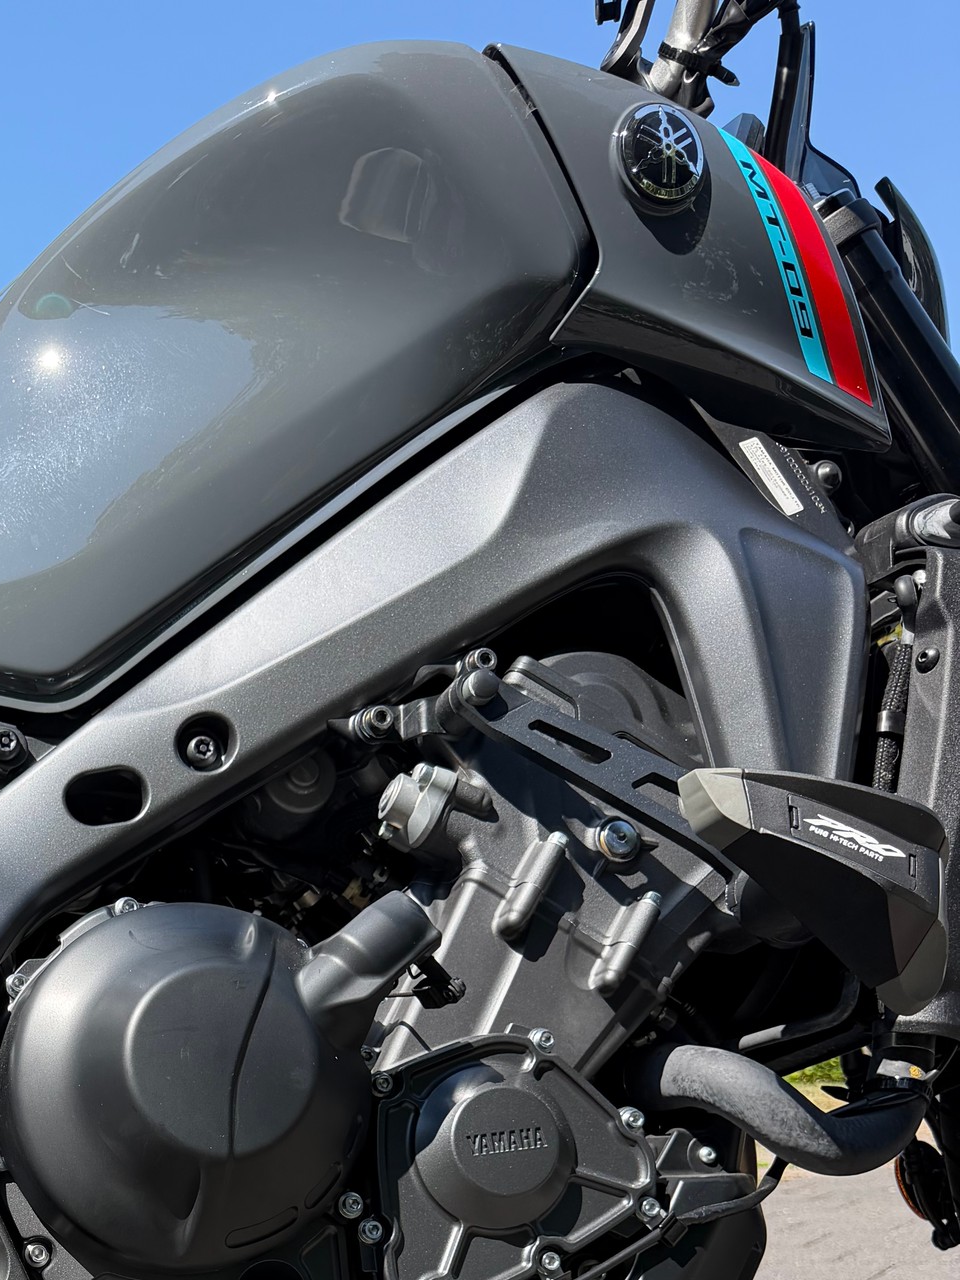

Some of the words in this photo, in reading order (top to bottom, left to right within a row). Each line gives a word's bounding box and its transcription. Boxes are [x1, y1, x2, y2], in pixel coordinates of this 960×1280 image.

[739, 159, 813, 339] MT-09
[809, 825, 829, 838] PUIG
[829, 835, 858, 851] HI-TECH
[859, 847, 884, 862] PARTS
[465, 1126, 548, 1157] YAMAHA
